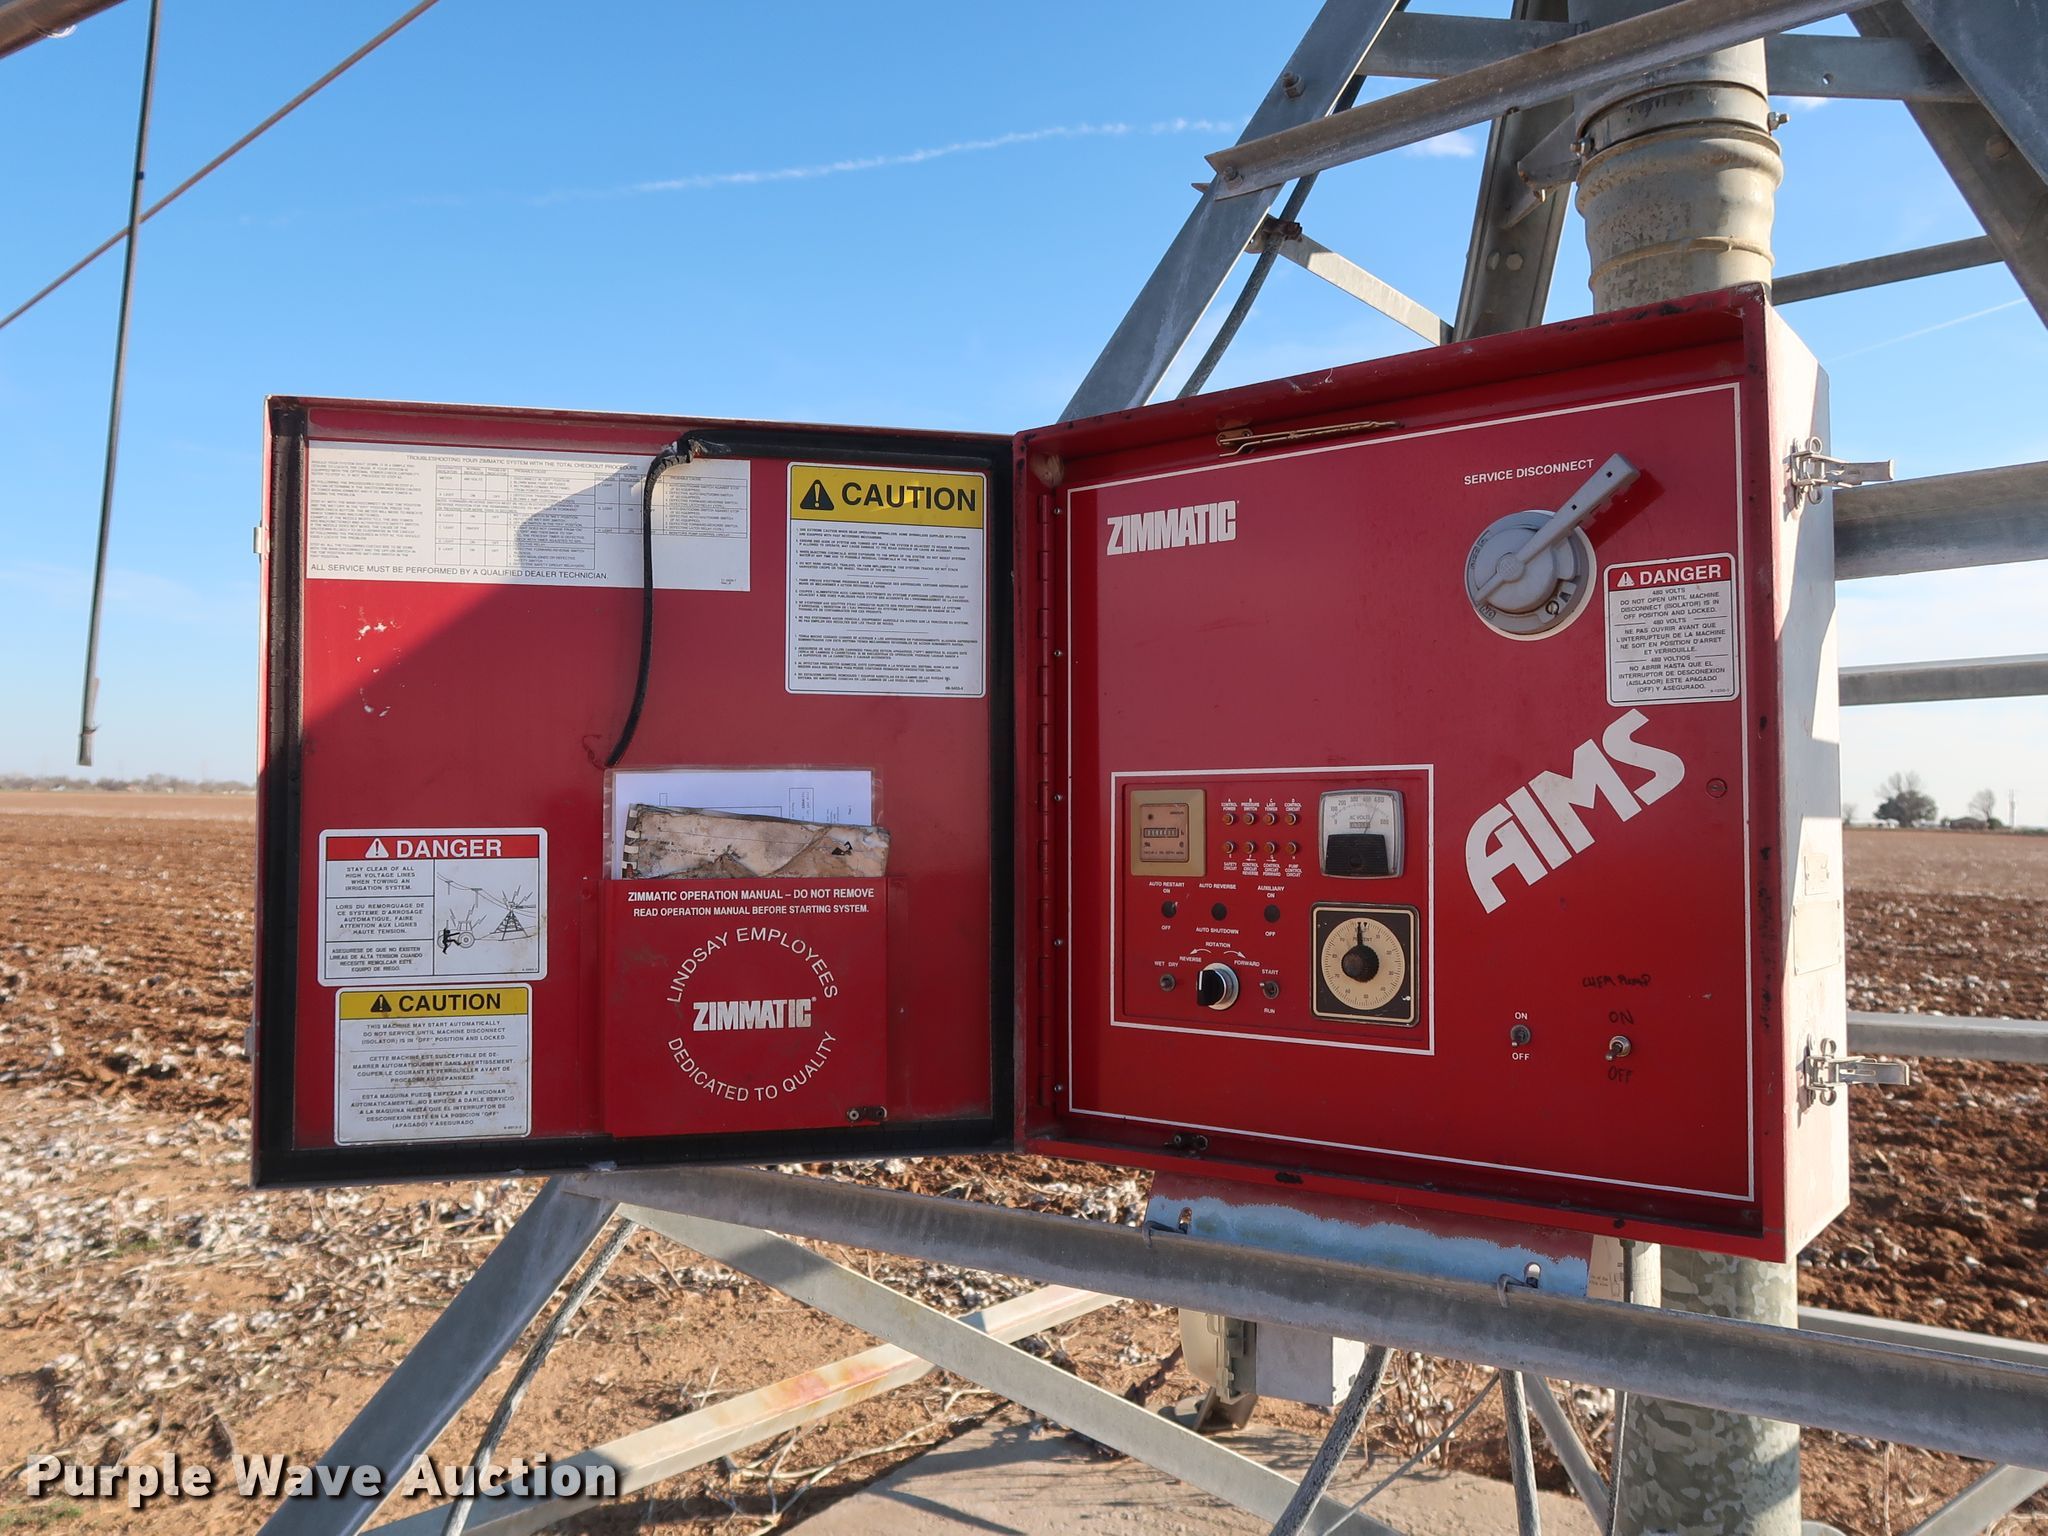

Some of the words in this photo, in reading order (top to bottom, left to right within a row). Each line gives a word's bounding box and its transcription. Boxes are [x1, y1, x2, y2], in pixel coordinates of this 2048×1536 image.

[1464, 470, 1512, 485] SERVICE
[1516, 459, 1594, 478] DISCONNECT
[841, 482, 976, 512] CAUTION
[1107, 500, 1237, 555] ZIMMATIC
[406, 567, 457, 575] PERFORMED
[559, 571, 607, 579] TECHNICIAN.
[1640, 565, 1721, 585] DANGER
[1621, 604, 1661, 612] DISCONNECT
[1664, 601, 1701, 609] (ISOLATOR)
[1464, 709, 1685, 914] AIMS
[396, 839, 501, 858] DANGER
[628, 892, 677, 902] ZIMMATIC
[680, 891, 739, 901] OPERATION
[741, 890, 783, 900] MANUAL
[793, 890, 808, 899] DO
[811, 889, 831, 899] NOT
[834, 888, 874, 899] REMOVE
[634, 908, 658, 917] READ
[661, 907, 711, 916] OPERATION
[714, 906, 750, 915] MANUAL
[752, 906, 787, 915] BEFORE
[789, 905, 831, 914] STARTING
[834, 905, 869, 913] SYSTEM.
[667, 932, 729, 1003] LINDSAY
[736, 927, 839, 999] EMPLOYEES
[399, 994, 500, 1011] CAUTION
[693, 998, 812, 1031] ZIMMATIC
[1609, 1010, 1633, 1024] ON
[668, 1037, 749, 1101] DEDICATED
[754, 1085, 778, 1101] TO
[782, 1031, 837, 1092] QUALITY
[1608, 1067, 1632, 1084] OFF
